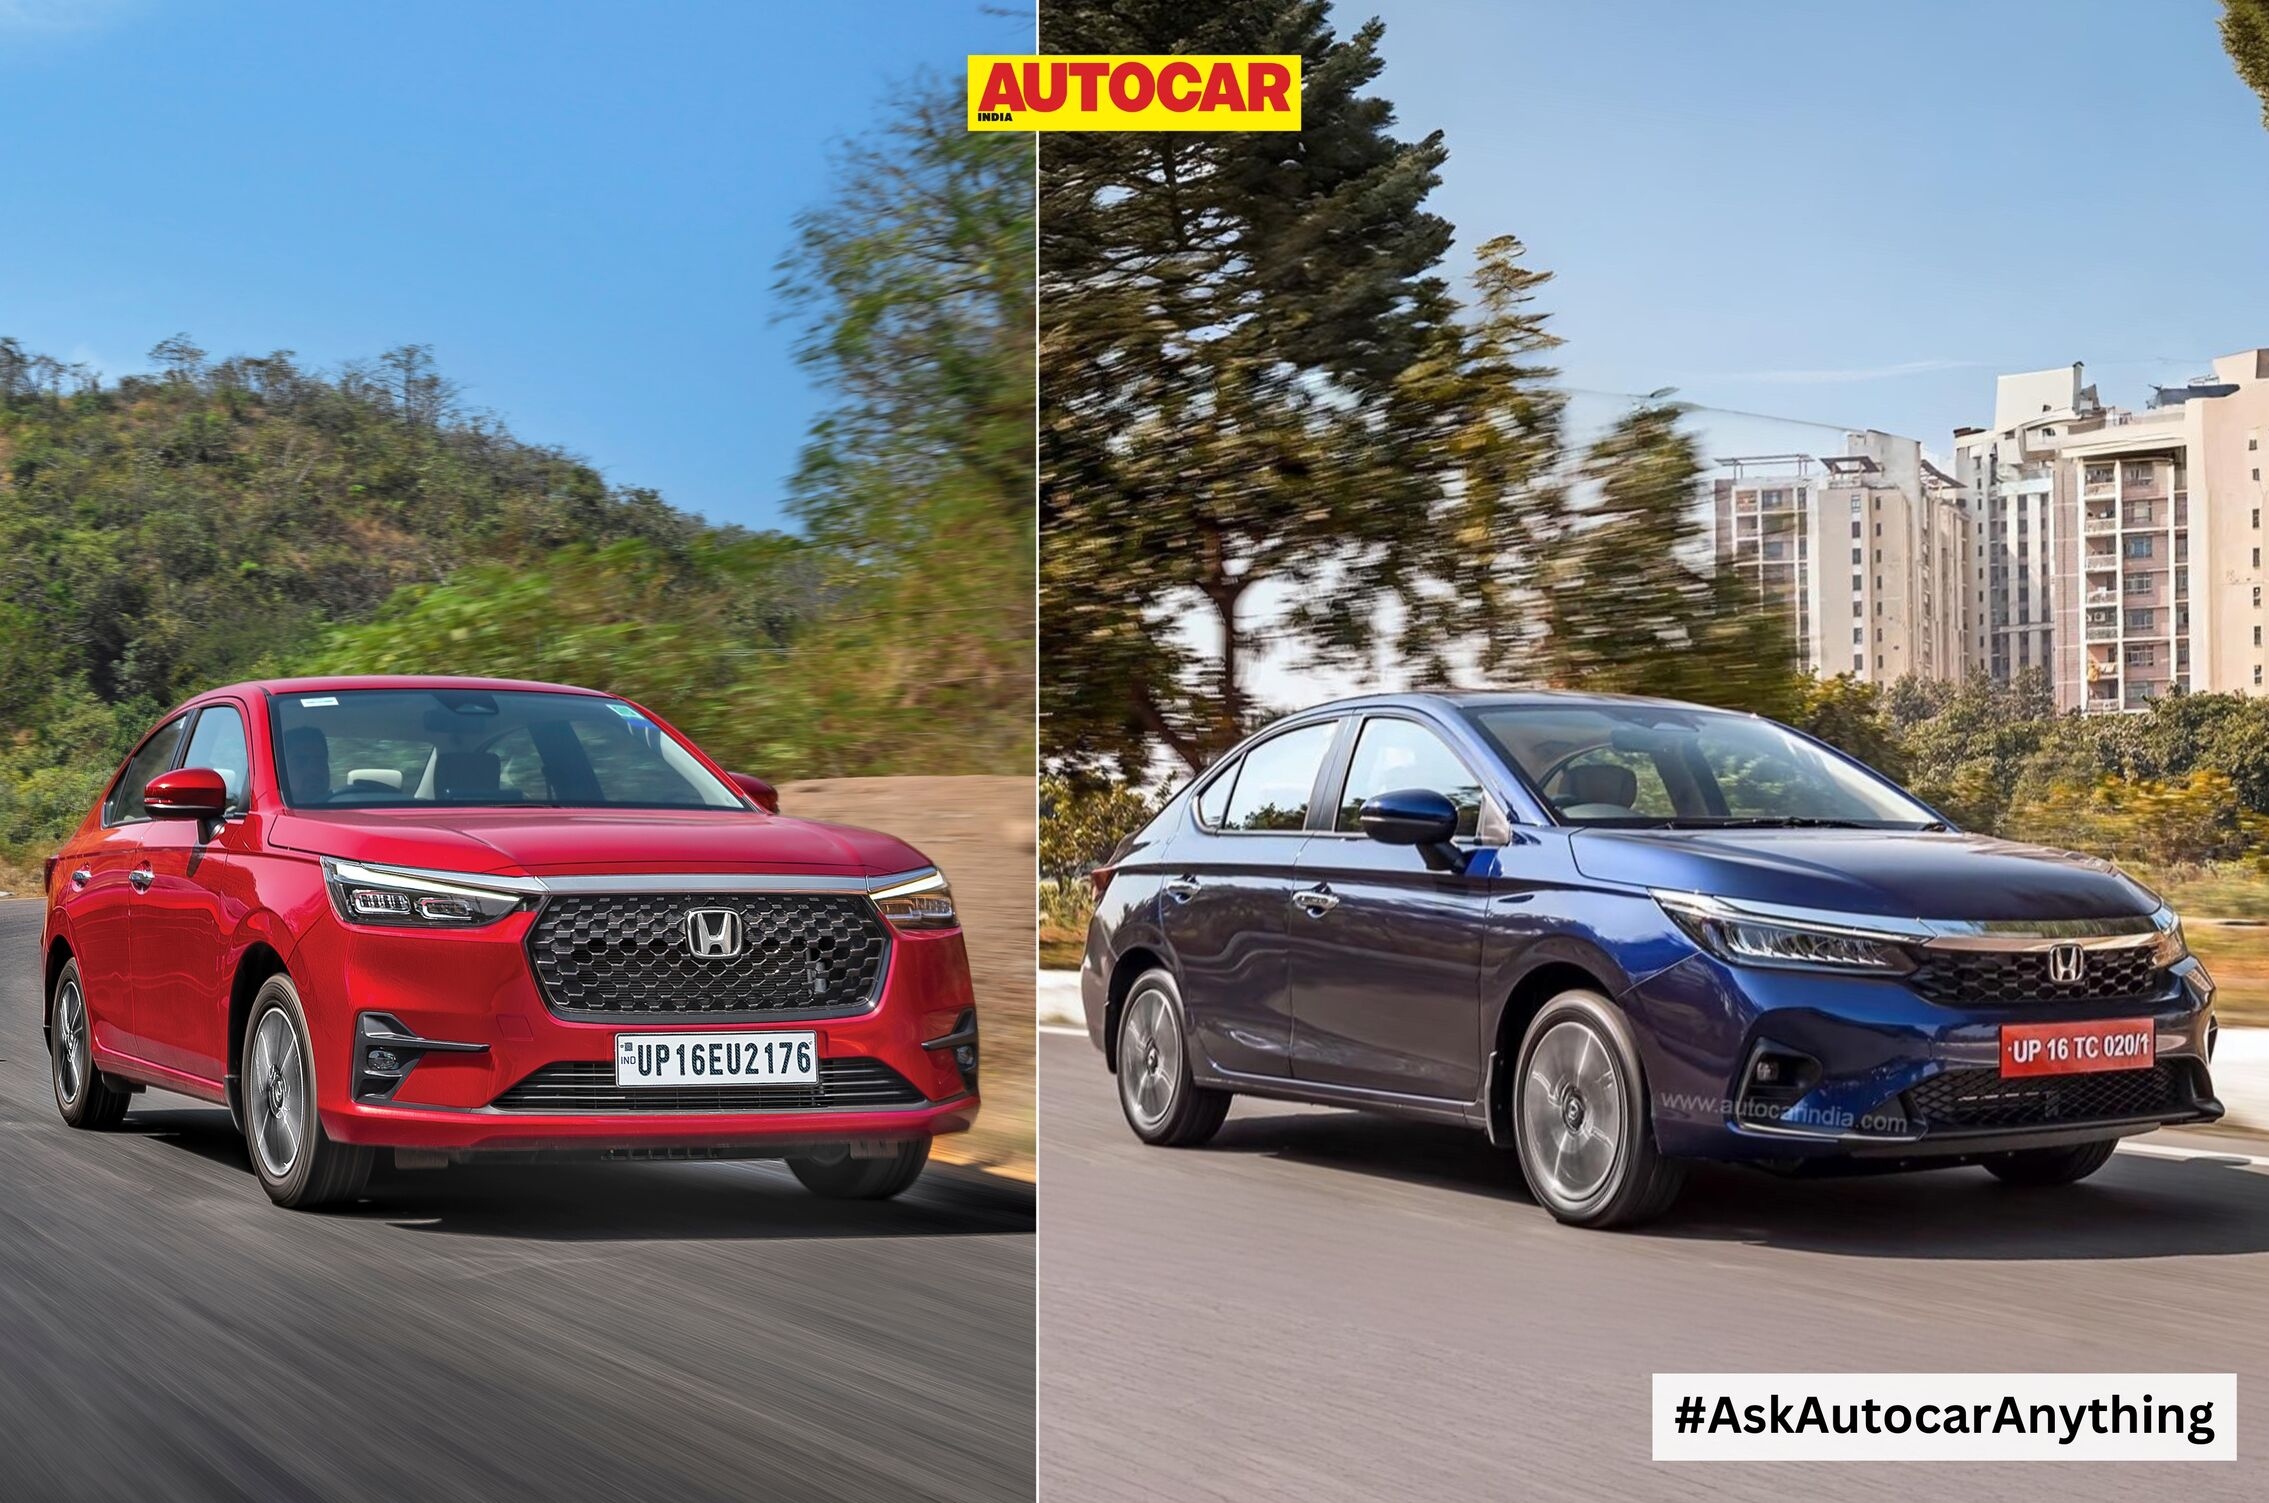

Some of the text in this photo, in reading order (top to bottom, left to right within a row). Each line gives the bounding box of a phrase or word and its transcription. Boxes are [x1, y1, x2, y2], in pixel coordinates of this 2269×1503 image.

[620, 1055, 636, 1065] IND
[637, 1041, 811, 1076] UP16EU2176
[2013, 1039, 2042, 1063] UP
[2047, 1038, 2069, 1060] 16
[2073, 1036, 2099, 1058] TC
